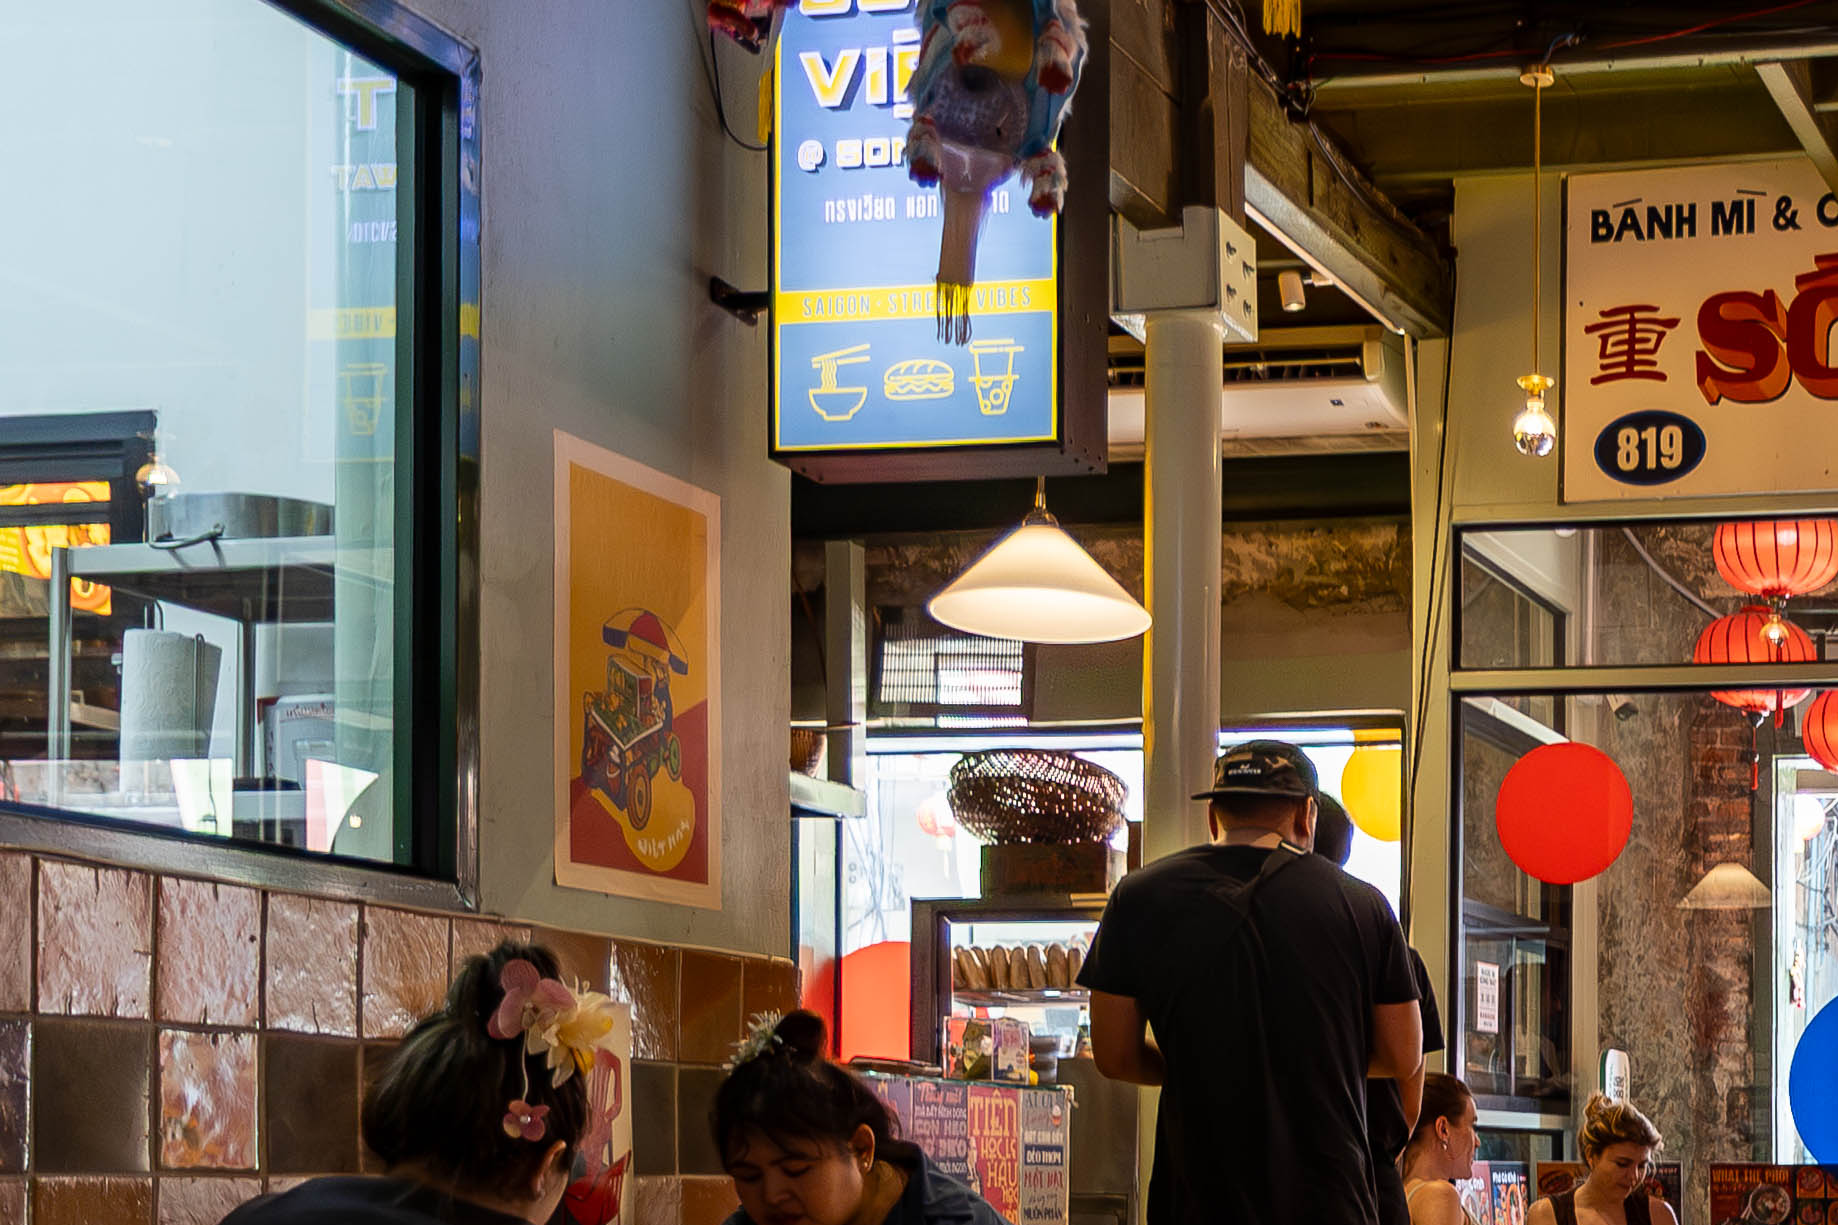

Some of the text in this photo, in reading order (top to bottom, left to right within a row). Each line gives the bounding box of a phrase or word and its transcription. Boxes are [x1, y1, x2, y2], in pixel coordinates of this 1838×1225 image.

[1773, 196, 1801, 231] &
[803, 296, 869, 317] SAIGON
[976, 287, 1031, 309] VIBES
[1616, 425, 1683, 471] 819
